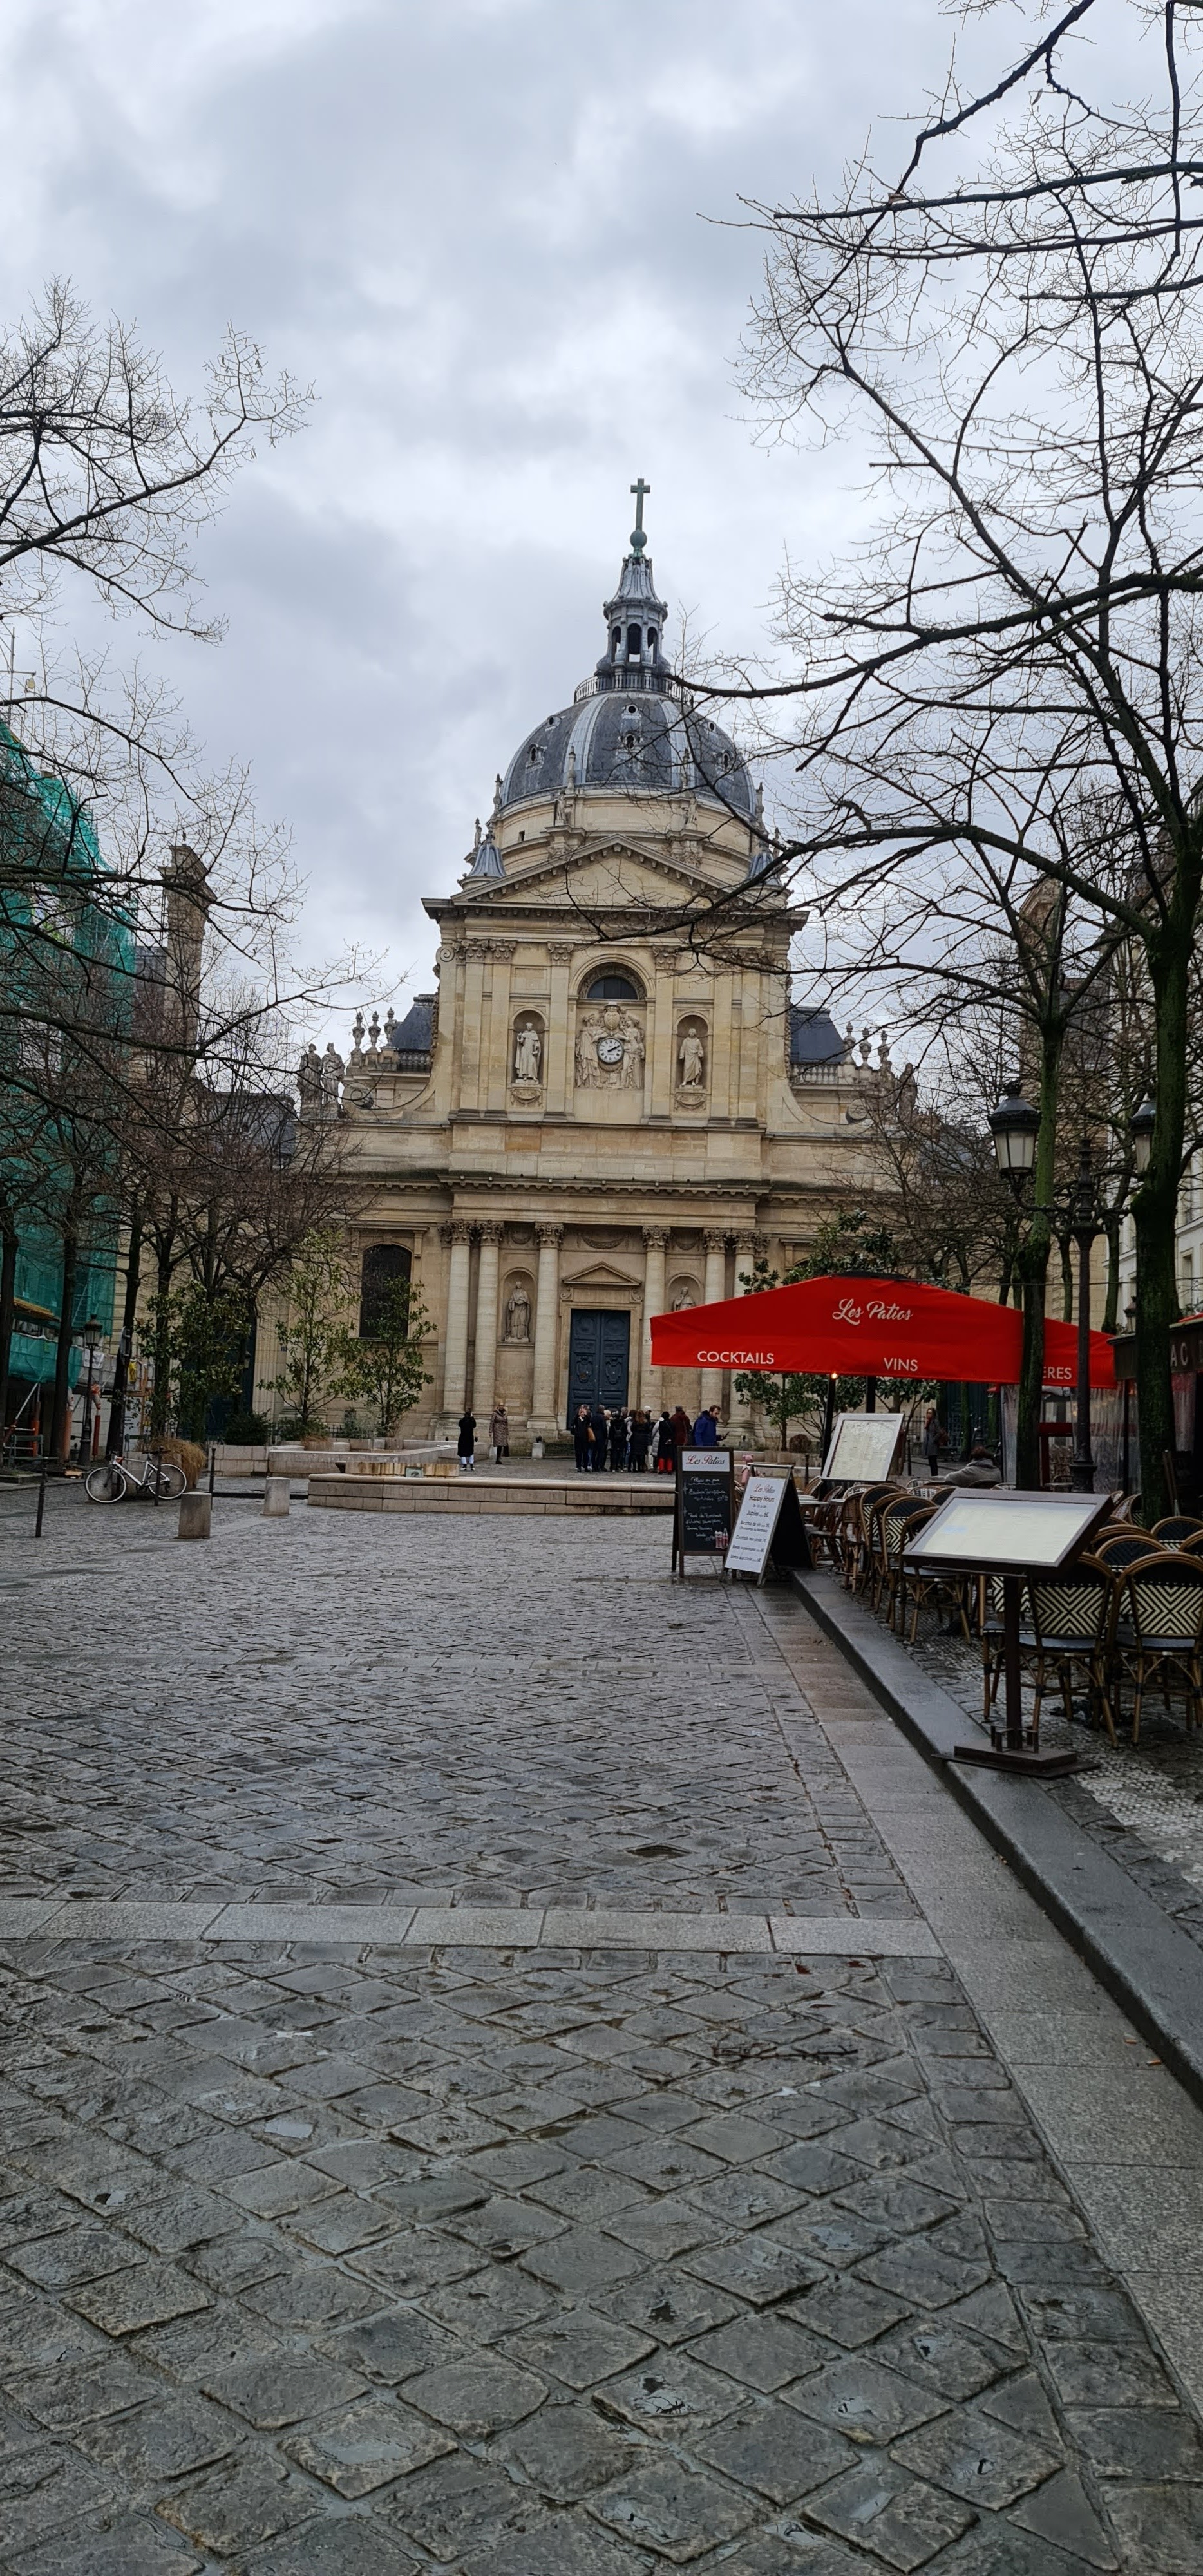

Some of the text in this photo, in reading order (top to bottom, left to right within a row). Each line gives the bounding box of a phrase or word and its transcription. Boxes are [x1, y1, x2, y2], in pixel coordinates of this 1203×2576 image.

[832, 1298, 913, 1325] Les Patios
[697, 1351, 774, 1364] COCKTAILS
[884, 1358, 918, 1372] VINS
[686, 1455, 725, 1464] Les Patios
